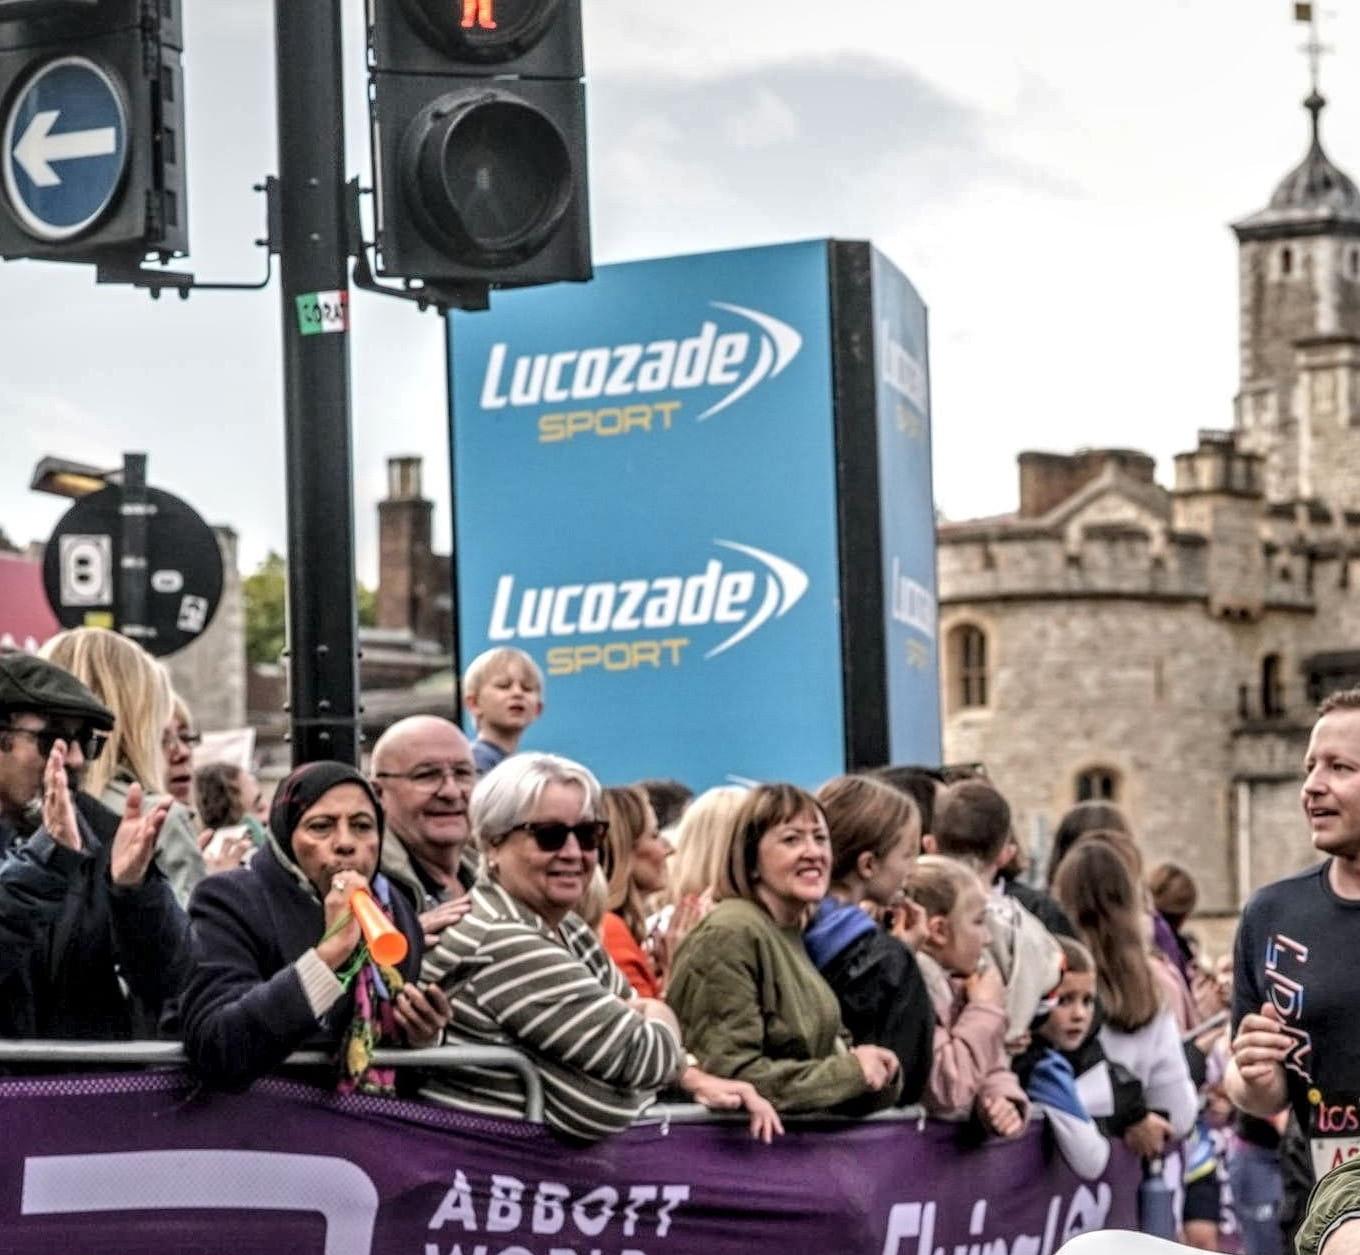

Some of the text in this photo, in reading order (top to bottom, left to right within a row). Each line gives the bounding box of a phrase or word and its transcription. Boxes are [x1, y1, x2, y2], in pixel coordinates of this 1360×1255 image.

[480, 322, 748, 409] Lucozade
[539, 401, 682, 442] SPORT
[488, 560, 753, 640] Lucozade
[547, 638, 689, 676] SPORT
[428, 1169, 691, 1239] ABBOTT
